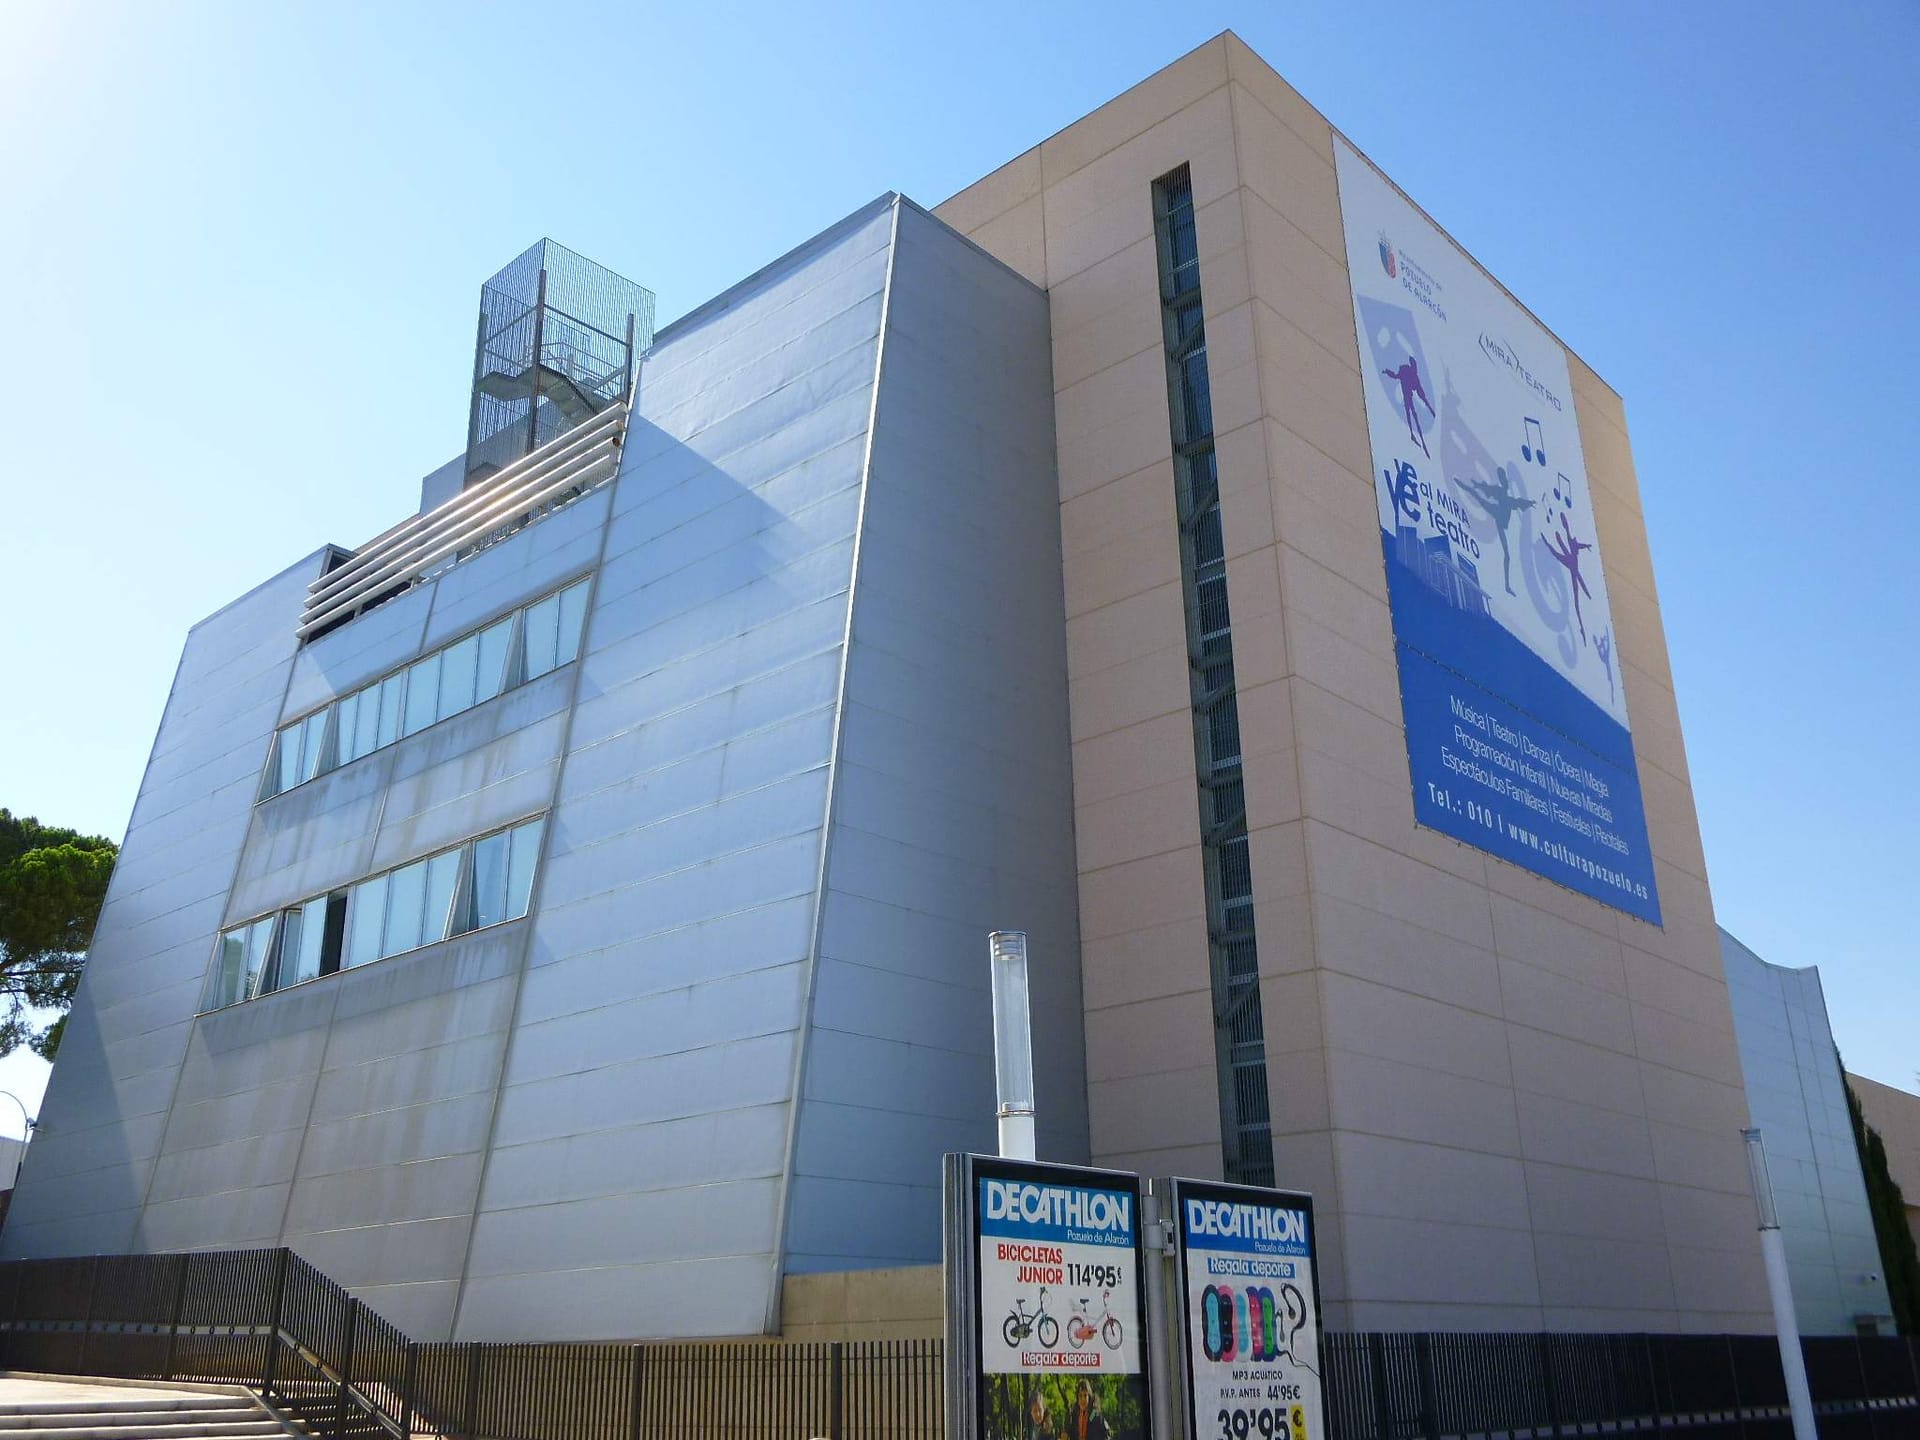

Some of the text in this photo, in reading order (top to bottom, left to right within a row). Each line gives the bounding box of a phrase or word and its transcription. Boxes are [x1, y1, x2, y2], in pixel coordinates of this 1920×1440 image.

[1519, 364, 1562, 412] TEATRO
[1420, 482, 1432, 501] al
[1428, 501, 1480, 559] teatro
[1450, 695, 1486, 731] Música
[1489, 716, 1519, 748] Teatro
[1523, 735, 1552, 766] Danza
[1454, 724, 1520, 775] Programación
[1519, 759, 1547, 790] Infantil
[1441, 745, 1505, 795] Espectáculos
[1505, 778, 1549, 816] Familiares
[1552, 802, 1592, 838] Festivales
[1428, 782, 1462, 816] Tel.:
[1468, 801, 1492, 829] 010
[1508, 823, 1649, 900] www.culturapozuelo.es
[986, 1180, 1130, 1233] DECATHLON
[1187, 1199, 1305, 1243] DECATHLON
[1067, 1229, 1129, 1246] Pozuelo de Alarcón
[997, 1243, 1063, 1265] BICICLETAS
[1277, 1244, 1286, 1255] de
[1017, 1266, 1063, 1285] JUNIOR
[1210, 1257, 1291, 1279] Regala deporte
[1022, 1351, 1098, 1368] Regala deporte
[1232, 1370, 1249, 1381] MP3
[1238, 1387, 1261, 1399] ANTES
